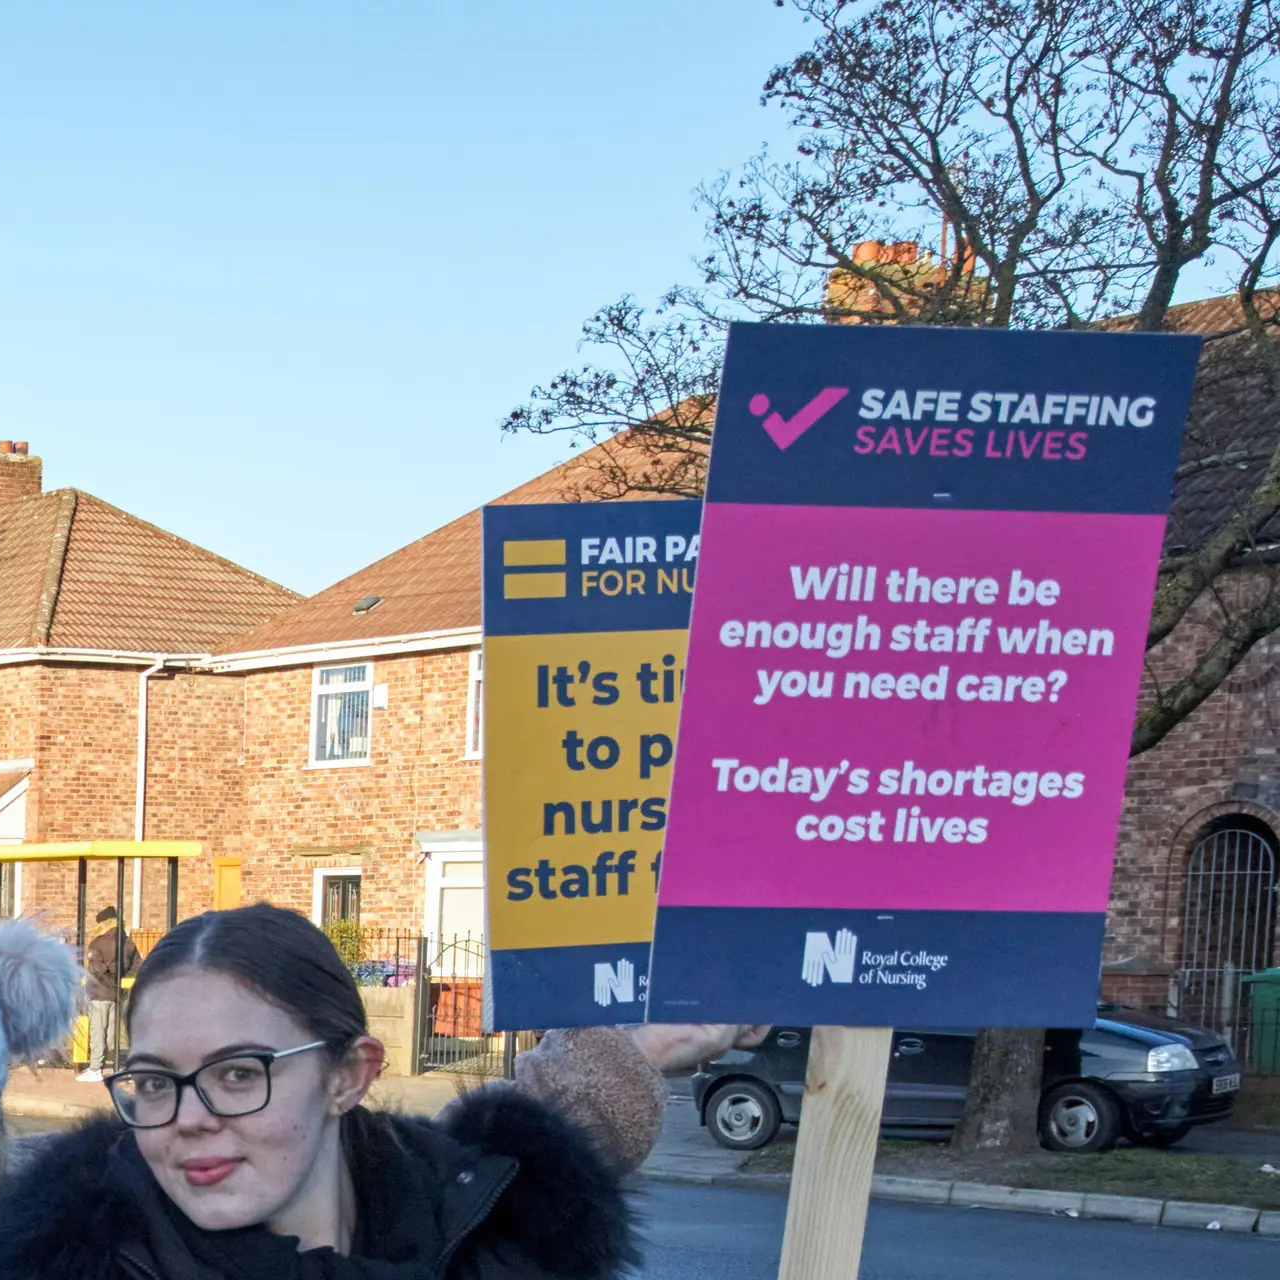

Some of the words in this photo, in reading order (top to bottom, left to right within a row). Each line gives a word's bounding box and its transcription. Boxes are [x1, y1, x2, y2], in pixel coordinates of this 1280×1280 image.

[859, 389, 961, 421] SAFE
[967, 392, 1156, 427] STAFFING
[855, 426, 973, 456] SAVES
[986, 430, 1087, 459] LIVES
[581, 537, 656, 564] FAIR
[665, 535, 700, 562] PA
[582, 570, 645, 596] FOR
[657, 568, 695, 594] NU
[790, 563, 876, 601] Will
[886, 567, 999, 604] there
[1008, 570, 1060, 606] be
[720, 615, 880, 658] enough
[890, 618, 992, 652] staff
[998, 620, 1114, 655] when
[637, 654, 684, 704] ti
[754, 670, 834, 705] you
[844, 666, 949, 700] need
[957, 670, 1067, 702] care?
[562, 731, 620, 771] to
[640, 734, 674, 779] p
[712, 758, 870, 802] Today’s
[878, 761, 1085, 805] shortages
[543, 797, 667, 836] nurs
[796, 811, 885, 841] cost
[894, 806, 988, 843] lives
[507, 850, 636, 901] staff
[859, 969, 874, 983] of
[876, 967, 927, 989] Nursing
[862, 950, 899, 971] Royal
[900, 951, 948, 971] College
